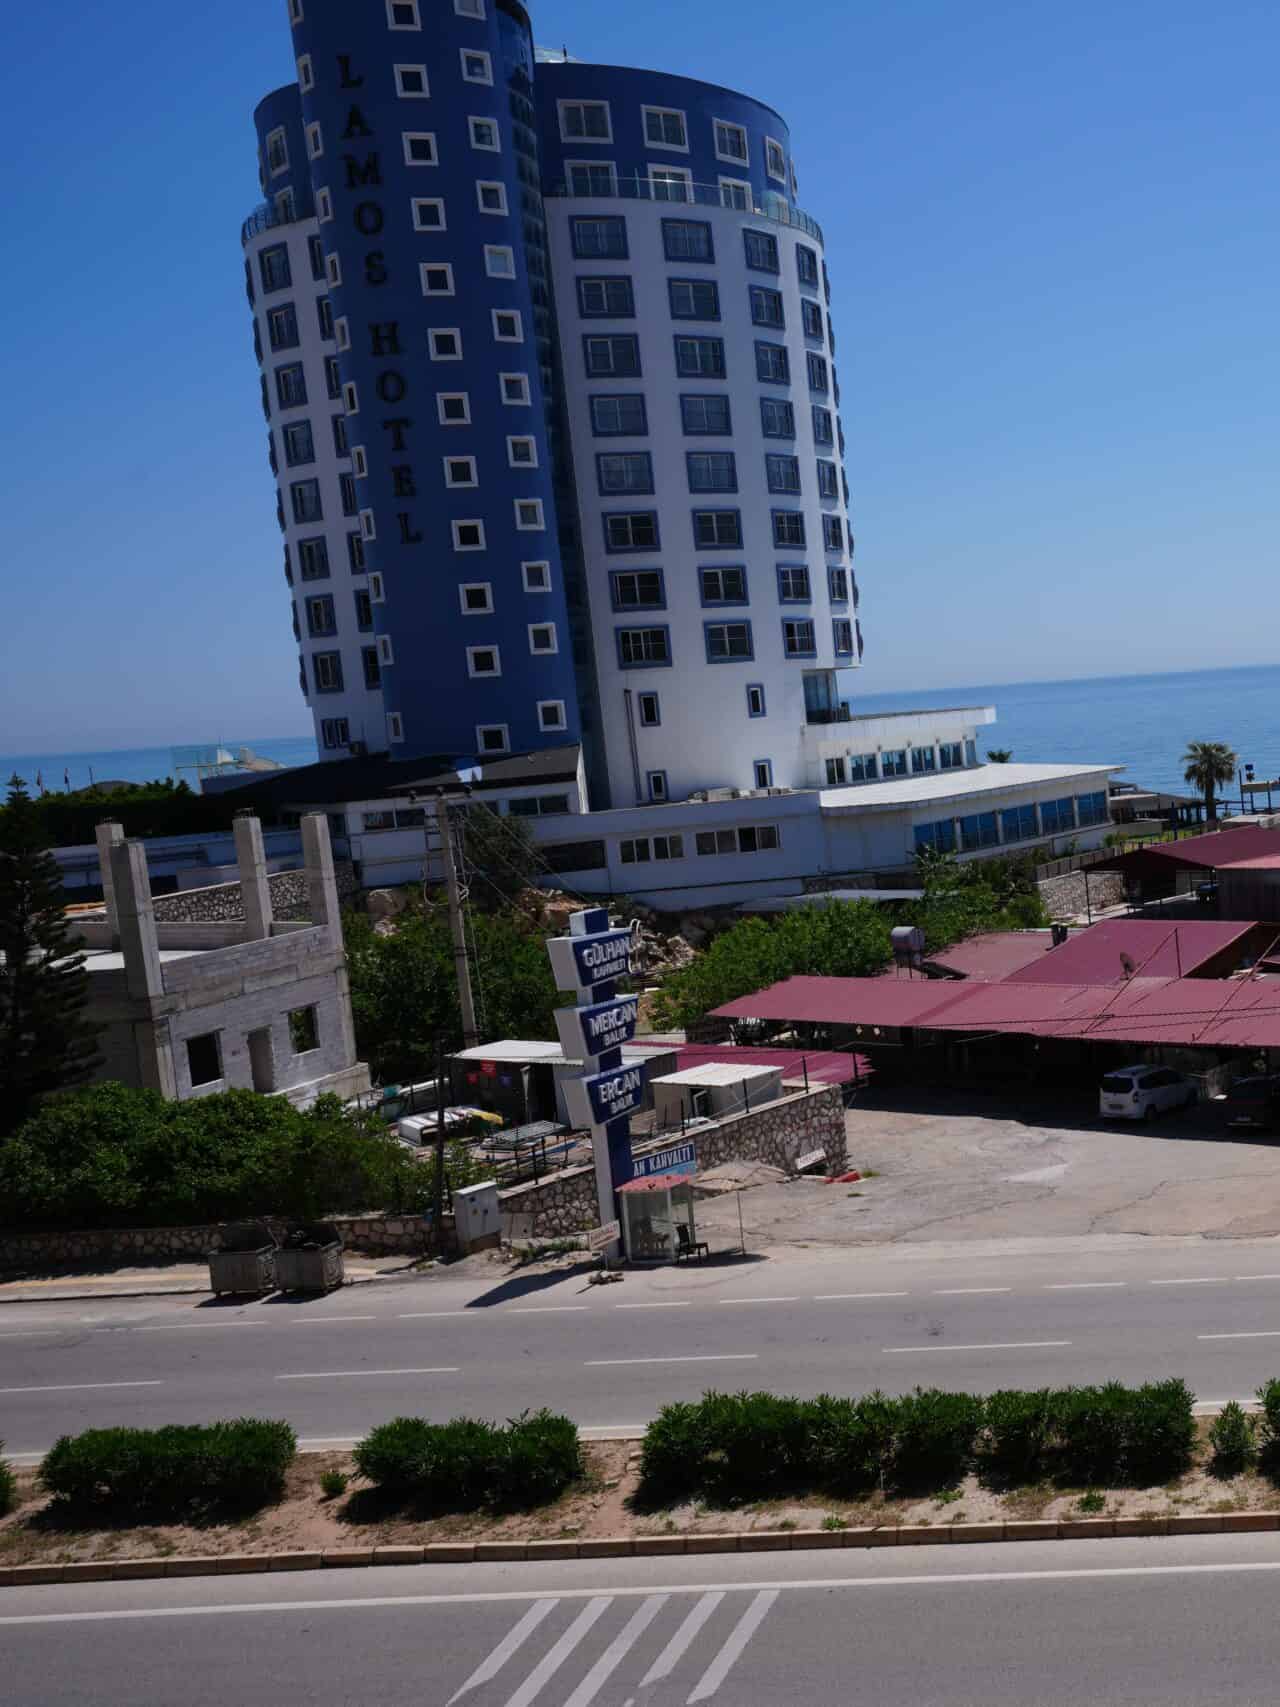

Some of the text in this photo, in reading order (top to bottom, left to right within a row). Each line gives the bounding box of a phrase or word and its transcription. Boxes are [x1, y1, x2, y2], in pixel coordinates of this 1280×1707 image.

[337, 55, 422, 545] LAMOS HOTEL
[589, 1000, 637, 1037] MERCAN
[598, 1069, 641, 1104] ERCAN
[649, 1146, 690, 1173] KAHVALTI
